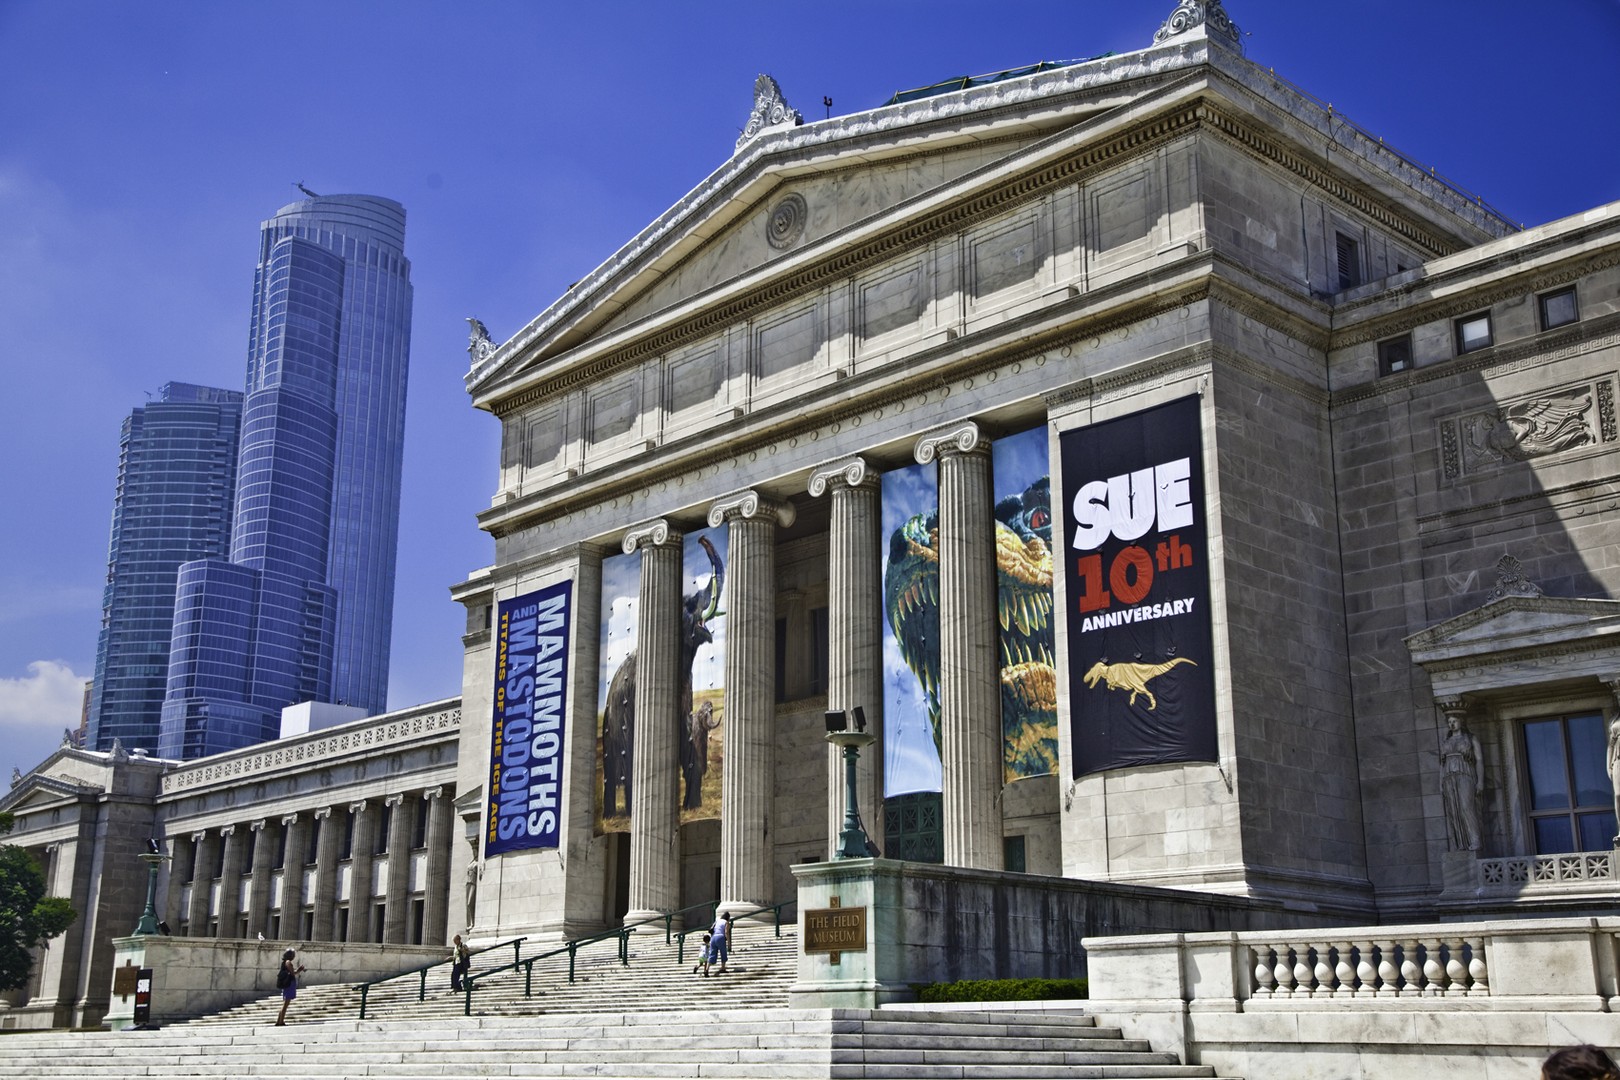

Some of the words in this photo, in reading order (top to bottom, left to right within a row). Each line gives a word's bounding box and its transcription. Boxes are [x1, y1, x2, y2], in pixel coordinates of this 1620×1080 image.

[1072, 457, 1194, 550] SUE
[1077, 535, 1193, 613] 10th
[512, 604, 538, 621] AND
[1081, 597, 1195, 633] ANNIVERSARY
[498, 611, 509, 682] TITANS
[497, 687, 505, 713] OF
[527, 593, 566, 836] MAMMOTHS
[494, 721, 503, 757] THE
[499, 617, 537, 840] MASTODONS
[492, 763, 500, 796] ICE
[489, 802, 498, 843] AGE
[810, 916, 829, 929] THE
[833, 914, 860, 928] FIELD
[813, 930, 856, 943] MUSEUM
